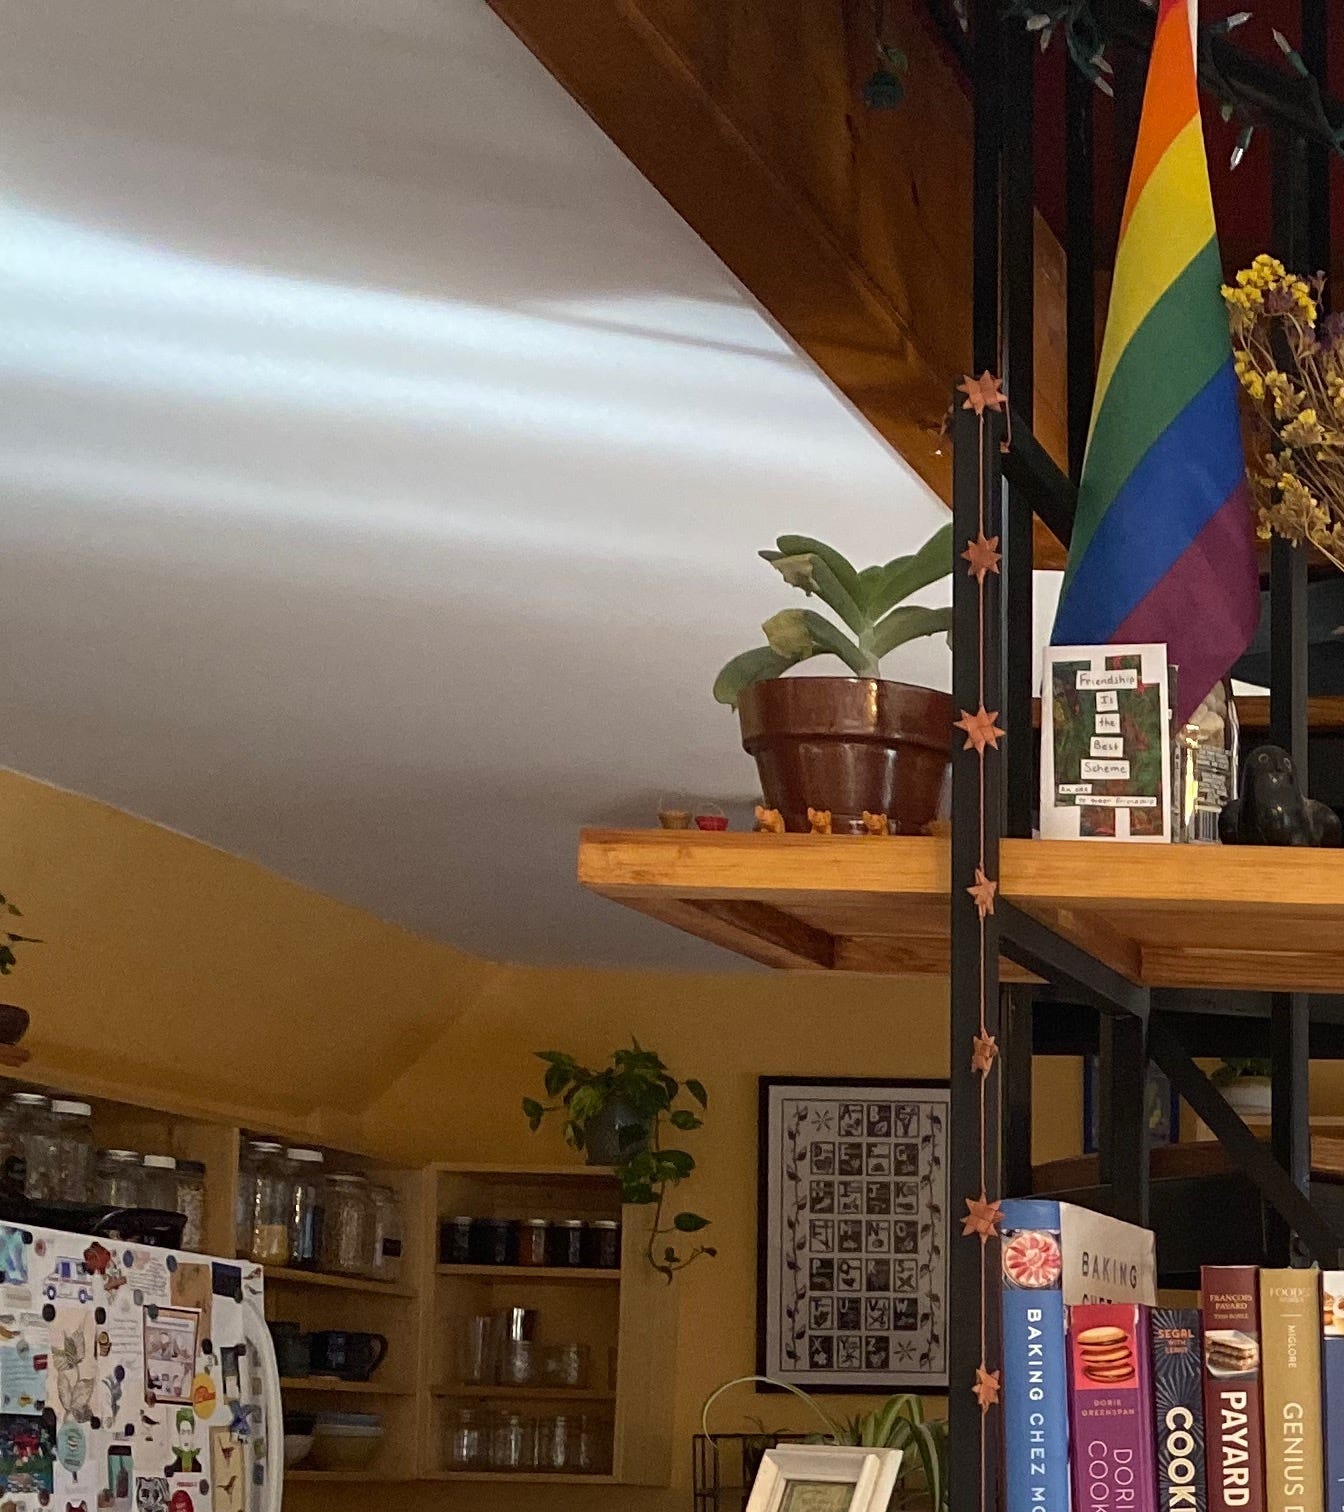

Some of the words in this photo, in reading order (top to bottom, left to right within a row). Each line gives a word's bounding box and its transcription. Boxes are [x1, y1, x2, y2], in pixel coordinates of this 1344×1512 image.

[1079, 673, 1136, 686] Friendship
[1099, 717, 1117, 728] the
[1093, 740, 1119, 752] Best
[1084, 761, 1127, 774] Scheme
[1158, 1328, 1195, 1339] SEGAL
[1286, 1324, 1297, 1368] MIGLORE
[1027, 1307, 1044, 1401] BAKING
[1028, 1412, 1045, 1477] CHEZ
[1220, 1391, 1250, 1507] PAYARD
[1282, 1402, 1305, 1496] GENIUS
